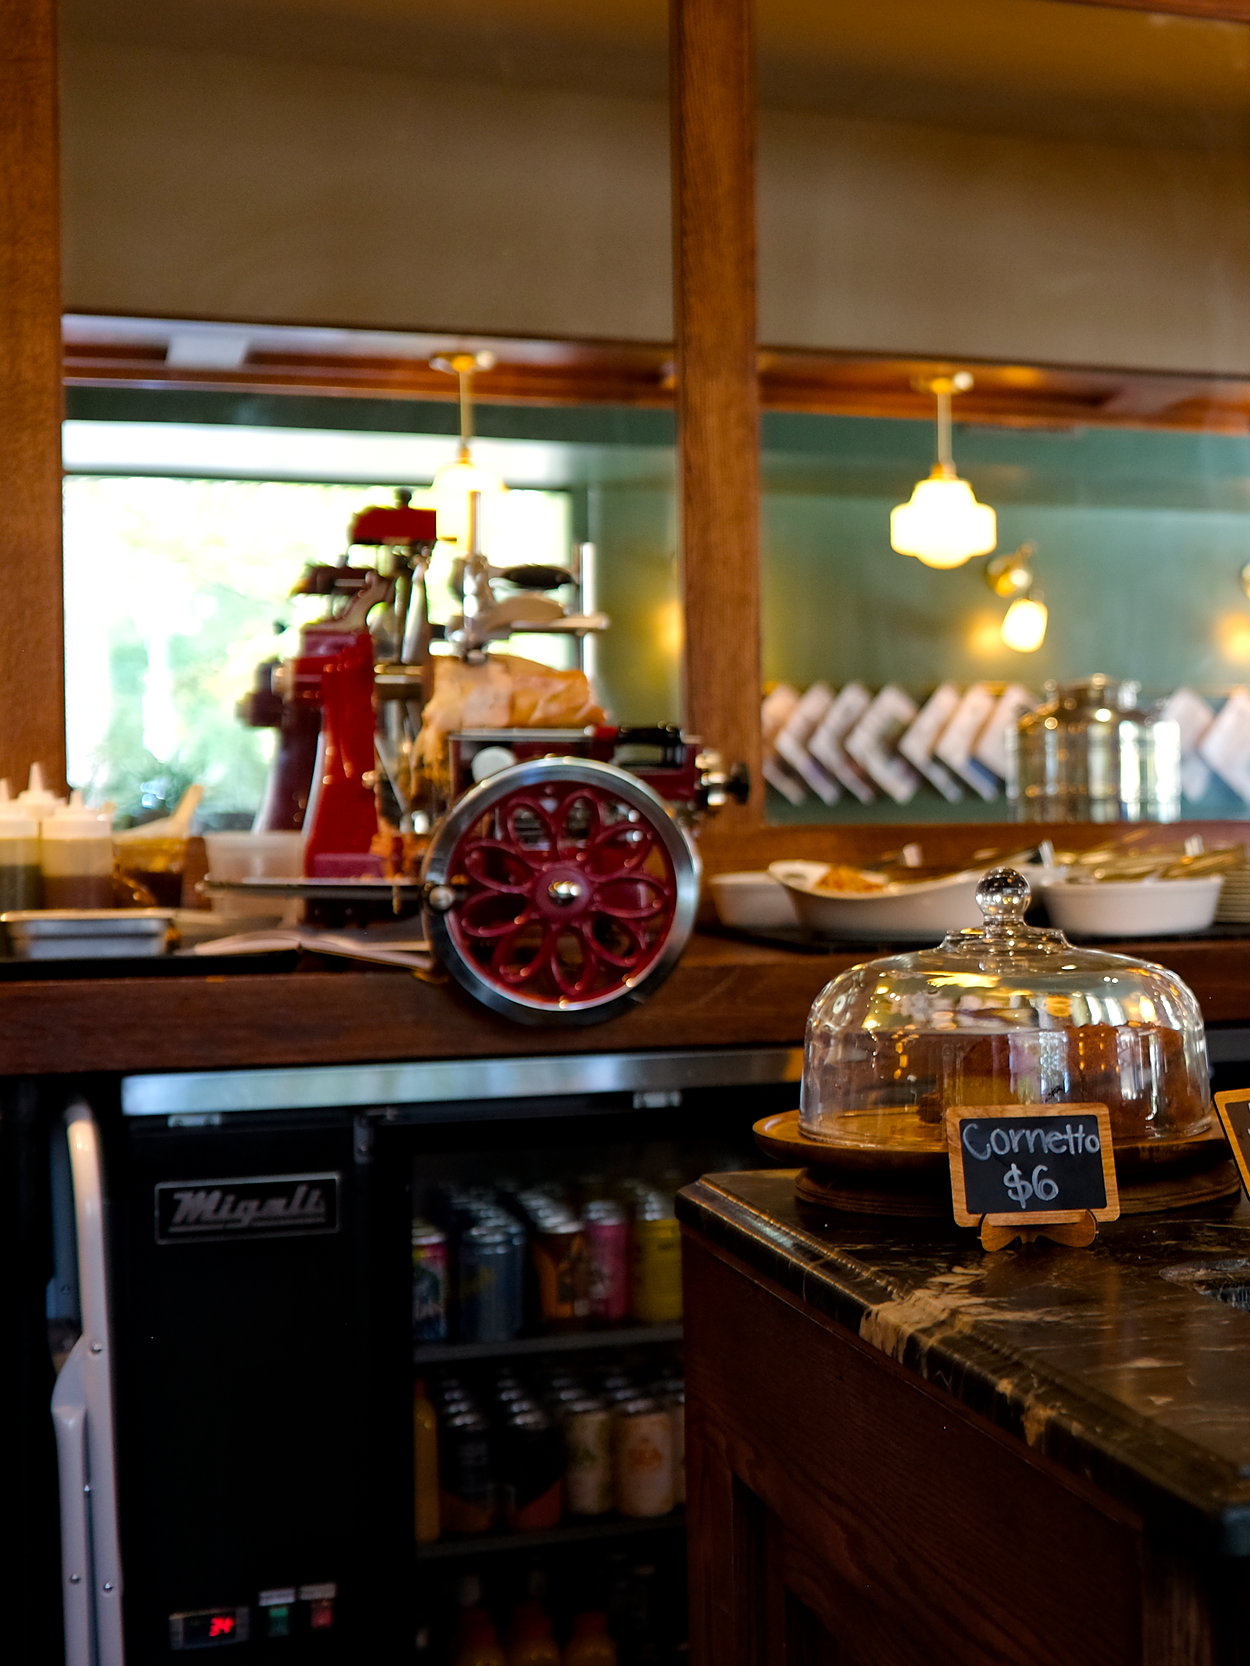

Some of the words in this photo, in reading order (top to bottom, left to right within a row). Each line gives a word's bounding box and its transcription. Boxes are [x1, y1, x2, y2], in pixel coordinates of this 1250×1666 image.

[962, 1123, 1100, 1161] Cornetto
[170, 1184, 327, 1230] Migali
[1003, 1163, 1060, 1209] $6
